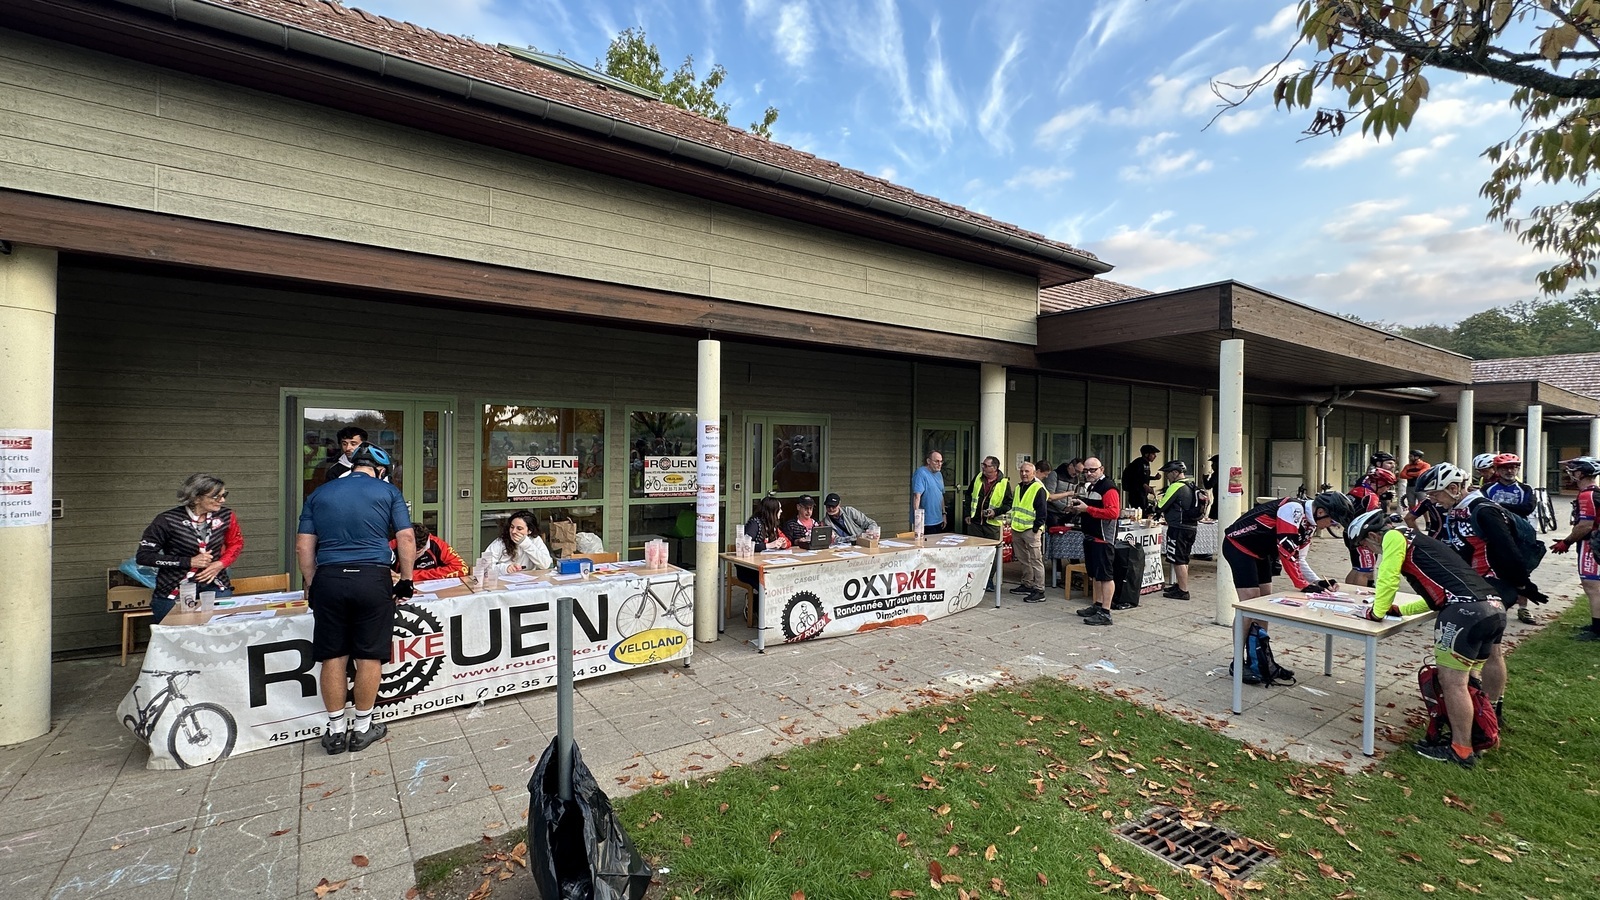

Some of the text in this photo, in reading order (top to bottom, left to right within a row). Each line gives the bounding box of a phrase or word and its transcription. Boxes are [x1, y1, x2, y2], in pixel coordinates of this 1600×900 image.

[514, 457, 573, 471] ROUEN
[1166, 537, 1177, 562] FOX
[880, 560, 903, 569] SPORT
[794, 575, 820, 584] CASQUE
[843, 568, 936, 601] OXYBIKE
[836, 600, 883, 617] Randonnée
[929, 592, 944, 600] tous
[804, 618, 826, 638] ROUEN
[388, 632, 445, 665] IKE
[618, 635, 684, 655] VELOLAND
[452, 643, 608, 680] www.rouenke.fr
[496, 682, 519, 694] 02
[521, 678, 540, 690] 35
[590, 664, 607, 674] 30
[269, 732, 289, 742] 45
[294, 726, 321, 737] rue
[371, 708, 399, 722] Eloi
[413, 694, 465, 712] ROUEN
